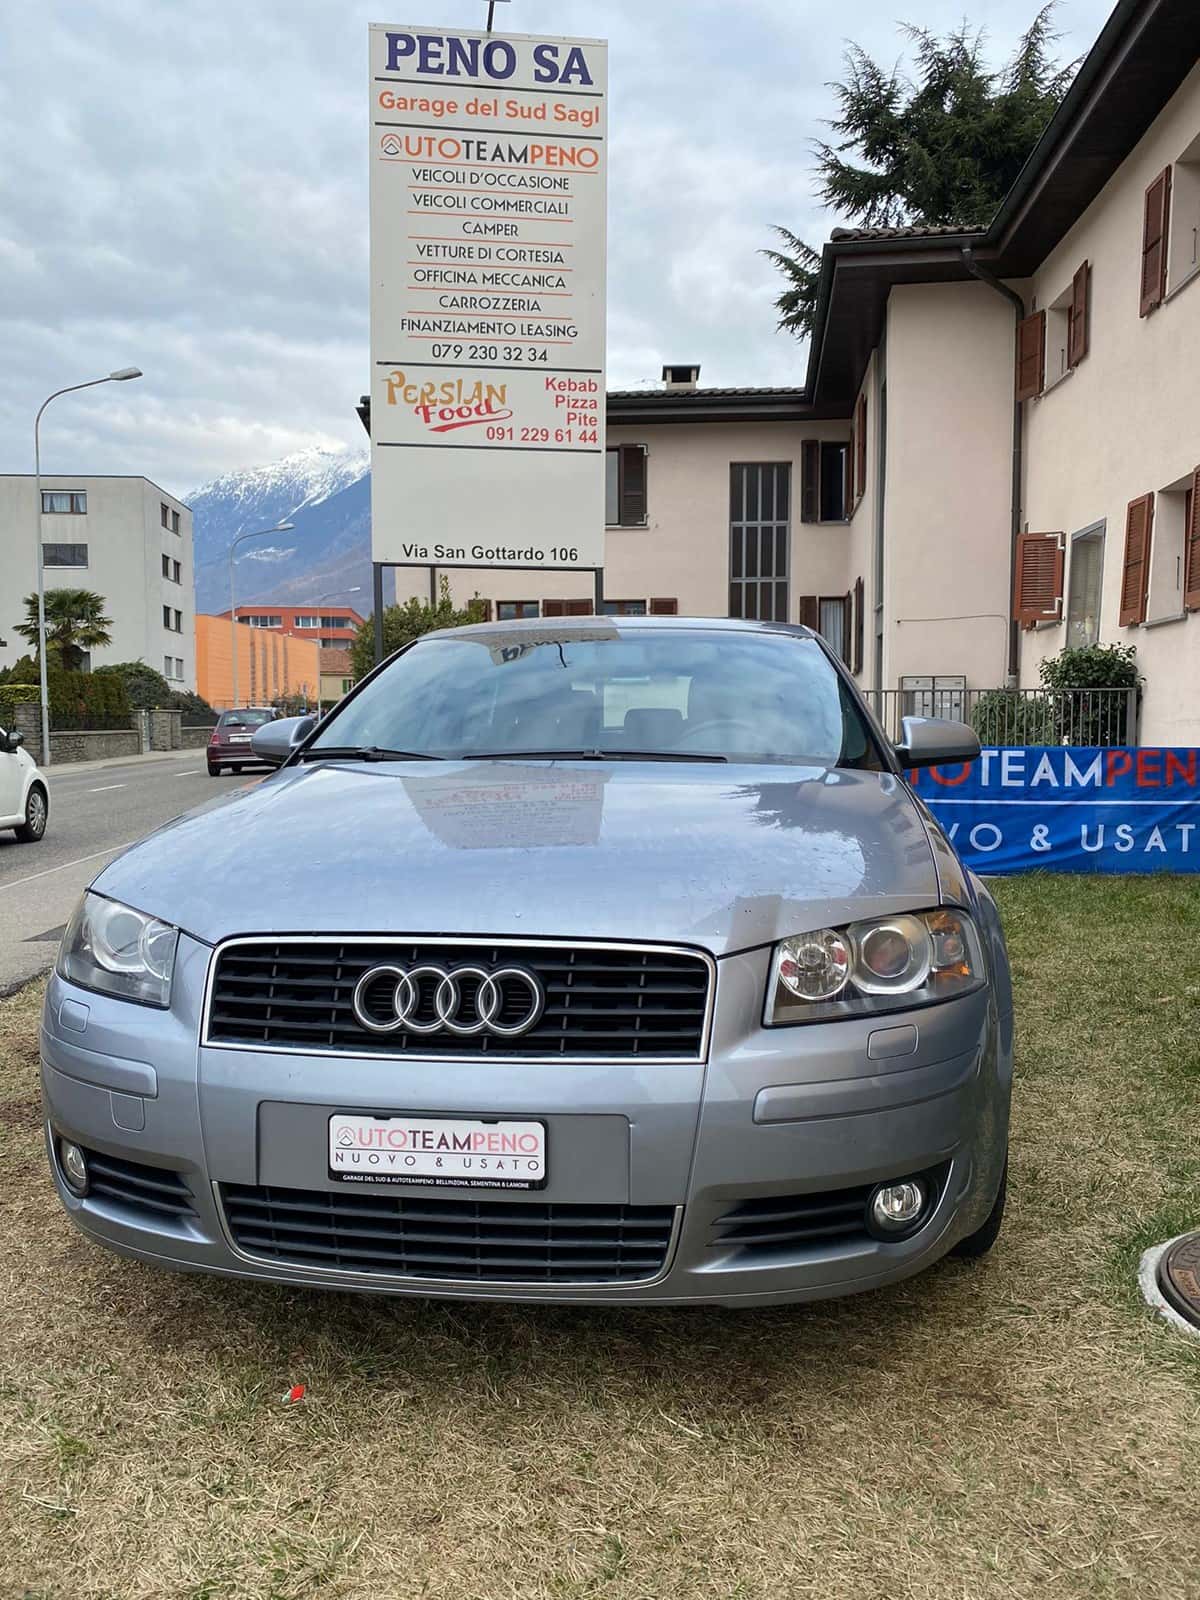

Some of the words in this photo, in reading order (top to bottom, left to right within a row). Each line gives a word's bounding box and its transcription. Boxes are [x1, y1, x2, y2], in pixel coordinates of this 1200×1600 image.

[385, 32, 516, 80] PENO
[533, 44, 593, 85] SA
[379, 91, 458, 116] Garage
[466, 98, 498, 116] del
[505, 101, 546, 120] Sud
[554, 104, 599, 127] Sagl
[412, 169, 465, 184] VEICOLI
[470, 173, 569, 189] D'OCCASIONE
[413, 193, 466, 208] VEICOLI
[471, 197, 568, 214] COMMERCIALI
[462, 222, 518, 237] CAMPER
[416, 244, 474, 259] VETTURE
[478, 246, 491, 259] DI
[496, 247, 564, 263] CORTESIA
[413, 269, 477, 284] OFFICINA
[482, 272, 566, 288] MECCANICA
[439, 295, 541, 312] CARROZZERIA
[401, 319, 516, 335] FINANZIAMENTO
[521, 323, 578, 338] LEASING
[432, 344, 462, 359] 079
[469, 346, 498, 360] 230
[503, 347, 523, 361] 32
[528, 347, 548, 362] 34
[545, 377, 597, 392] Kebab
[415, 399, 497, 424] Food
[555, 395, 597, 409] Pizza
[567, 412, 597, 426] Pite
[486, 427, 514, 441] 091
[521, 428, 549, 442] 229
[555, 429, 573, 442] 61
[579, 430, 598, 443] 44
[403, 544, 428, 558] Via
[434, 545, 465, 559] San
[472, 545, 544, 561] Gottardo
[550, 548, 578, 561] 106
[1030, 824, 1051, 852] &
[335, 1152, 416, 1166] NUOVO
[435, 1157, 443, 1167] &
[463, 1158, 540, 1171] USATO
